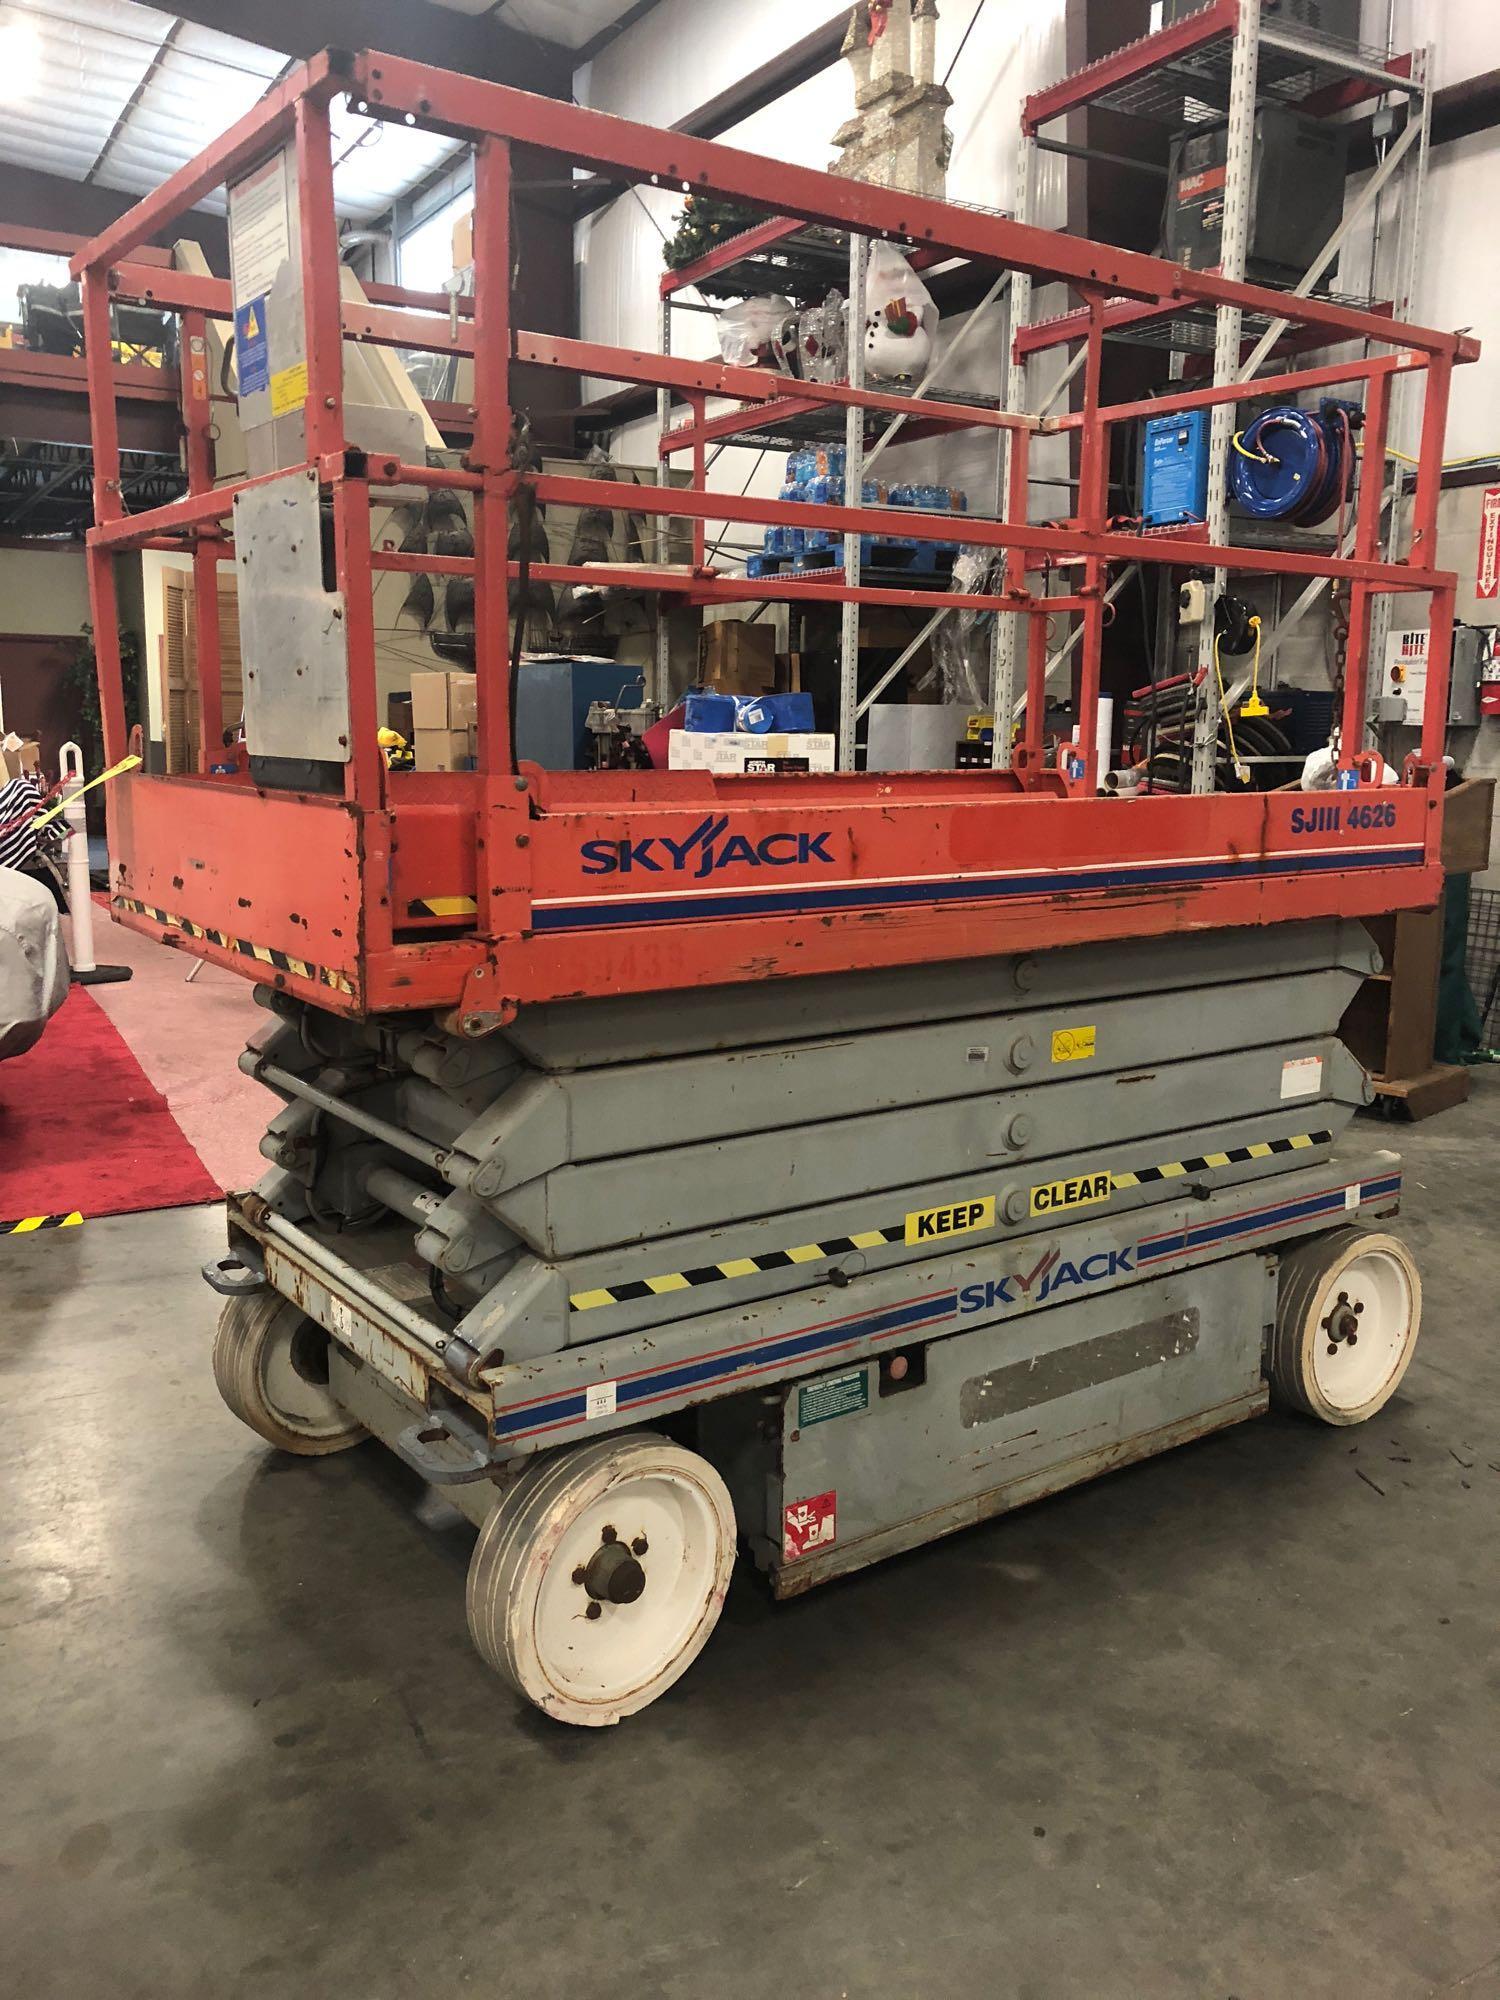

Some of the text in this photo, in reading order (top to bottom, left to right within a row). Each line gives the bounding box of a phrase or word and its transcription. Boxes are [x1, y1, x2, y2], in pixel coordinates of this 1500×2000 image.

[1485, 511, 1496, 590] EXTINGUISHER
[1402, 645, 1424, 656] HITE
[1403, 632, 1425, 644] RITE
[747, 763, 776, 772] STAR
[1291, 803, 1396, 833] SJIII 4626
[581, 815, 835, 878] SKYJACK
[918, 1175, 1108, 1237] KEEP CLEAR
[960, 1247, 1135, 1313] SKYJACK
